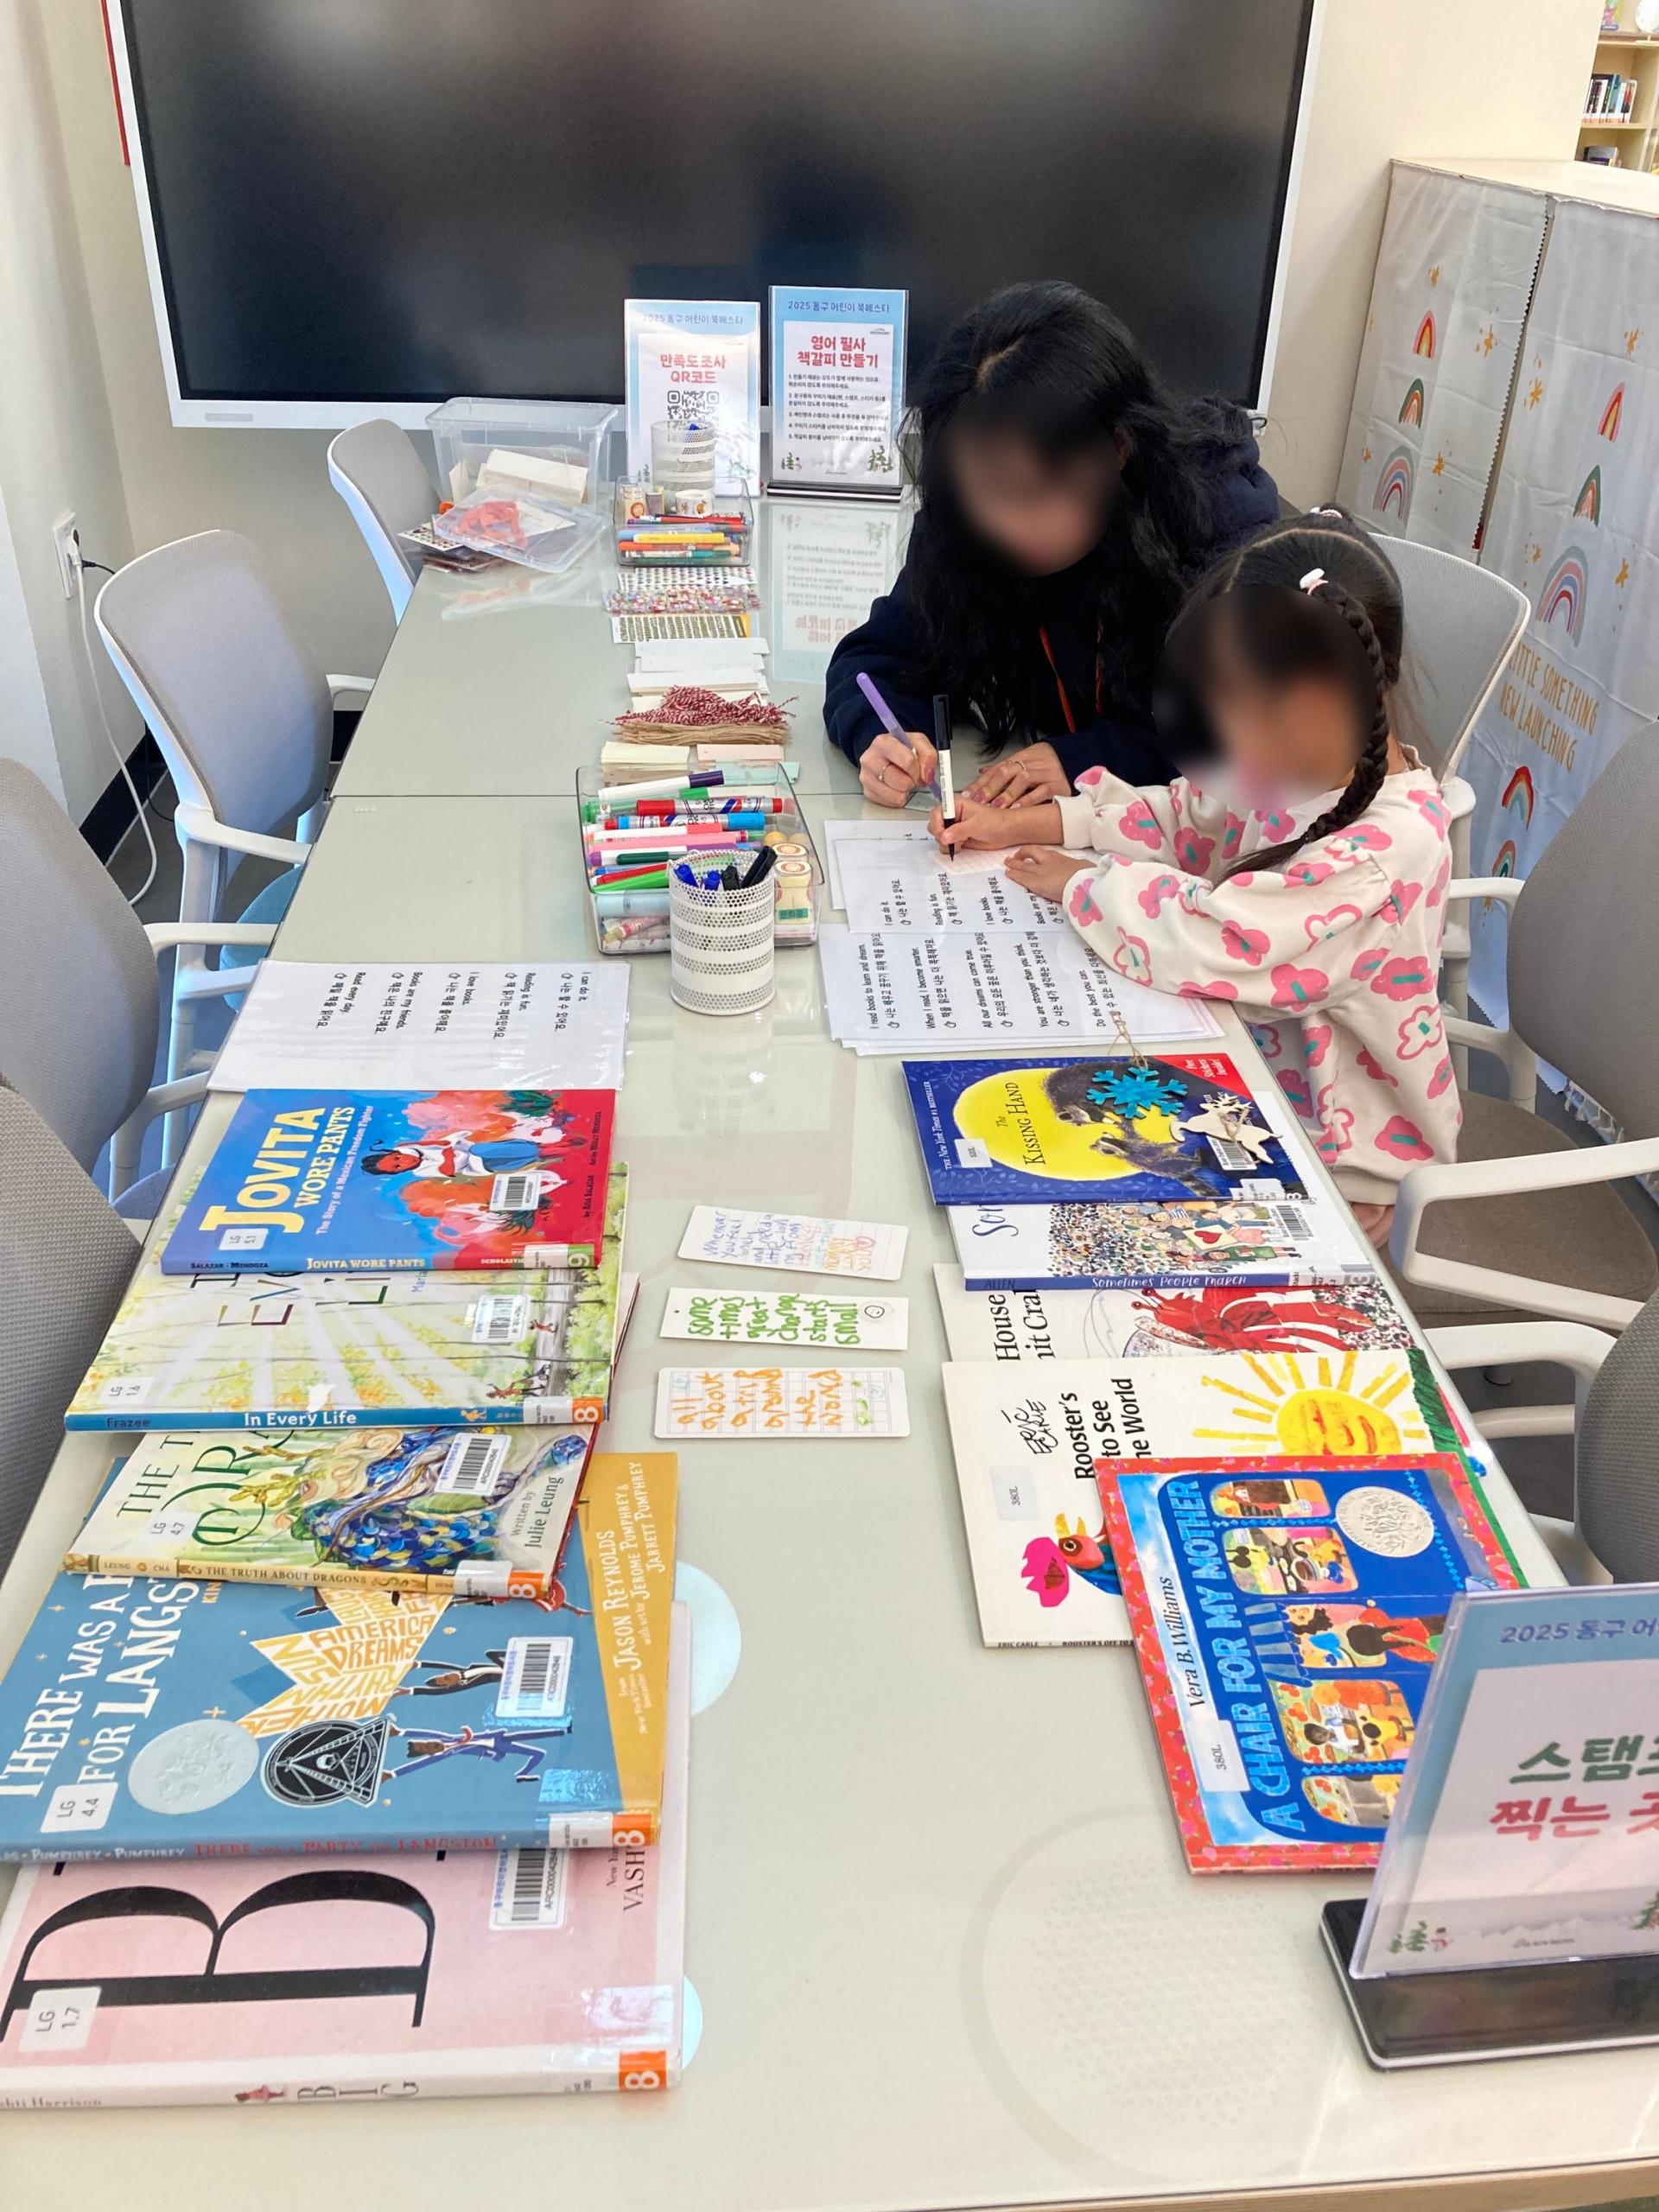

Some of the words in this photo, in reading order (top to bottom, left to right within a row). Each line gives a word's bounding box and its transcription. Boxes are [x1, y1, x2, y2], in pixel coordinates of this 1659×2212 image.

[812, 302, 830, 311] 동구
[830, 302, 855, 312] 어린이
[857, 303, 890, 313] 북페스타
[667, 315, 683, 324] 동구
[685, 315, 709, 324] 어린이
[712, 315, 743, 325] 북페스타
[811, 336, 836, 351] 영어
[840, 336, 866, 352] 필사
[798, 352, 836, 367] 책갈피
[840, 353, 878, 368] 만들기
[671, 371, 716, 384] QR코드
[1541, 664, 1599, 735] SOMETHING
[1498, 681, 1522, 721] NEW
[1517, 694, 1578, 772] LAUNCHING
[969, 963, 978, 976] come
[1020, 958, 1032, 967] you
[353, 972, 366, 985] Read
[410, 972, 423, 987] Books
[467, 976, 479, 987] love
[520, 973, 536, 992] Reading
[917, 969, 926, 988] become
[1024, 969, 1033, 980] than
[345, 987, 359, 1001] every
[388, 982, 402, 993] 책은
[406, 988, 415, 997] are
[446, 982, 459, 993] 나는
[561, 982, 573, 993] 나는
[1028, 982, 1042, 1003] stronger
[1083, 982, 1095, 992] you
[400, 999, 412, 1007] my
[865, 995, 876, 1010] books
[976, 988, 987, 1007] dreams
[1086, 994, 1097, 1006] best
[982, 1009, 990, 1019] our
[995, 1001, 1008, 1016] 우리의
[1036, 1006, 1046, 1014] are
[925, 1014, 936, 1028] When
[1039, 1017, 1049, 1027] You
[924, 1081, 937, 1108] BESTSELLER
[1005, 1082, 1028, 1115] HAND
[358, 1106, 373, 1127] Fighter
[929, 1116, 942, 1132] Times
[995, 1116, 1008, 1127] The
[346, 1128, 365, 1155] Freedom
[933, 1132, 946, 1144] York
[1017, 1118, 1046, 1165] KISSING
[294, 1156, 336, 1208] WORE
[316, 1107, 356, 1154] PANTS
[938, 1145, 950, 1158] New
[199, 1107, 326, 1233] JOVITA
[336, 1156, 356, 1185] Mexican
[943, 1159, 952, 1170] THE
[322, 1200, 340, 1219] Story
[315, 1221, 331, 1235] The
[307, 1258, 347, 1269] JOVITA
[350, 1258, 386, 1269] WORE
[389, 1258, 425, 1268] PANTS
[985, 1279, 1015, 1289] ALLEN
[688, 1296, 718, 1336] some
[718, 1297, 745, 1339] times
[745, 1296, 776, 1338] great
[988, 1294, 1020, 1361] House
[696, 1372, 726, 1430] about
[1111, 1378, 1142, 1434] World
[107, 1417, 151, 1428] Frazee
[245, 1413, 260, 1427] In
[266, 1412, 317, 1429] Every
[322, 1410, 357, 1426] Life
[1092, 1400, 1115, 1433] See
[1061, 1392, 1096, 1479] Rooster's
[1101, 1438, 1121, 1459] to
[118, 1464, 180, 1516] THE
[535, 1476, 563, 1514] Leung
[628, 1462, 653, 1521] PUMPHREY
[510, 1503, 530, 1536] Written
[522, 1491, 536, 1501] by
[615, 1492, 639, 1551] PUMPHREY
[524, 1519, 547, 1548] Julie
[1166, 1480, 1228, 1580] MOTHER
[645, 1518, 665, 1573] JARRETT
[104, 1561, 131, 1571] LEUNG
[207, 1566, 228, 1577] THE
[231, 1567, 270, 1579] TRUTH
[272, 1571, 309, 1582] ABOUT
[313, 1573, 366, 1586] DRAGONS
[596, 1529, 629, 1612] REYNOLDS
[627, 1554, 650, 1599] JEROME
[1160, 1576, 1185, 1644] Williams
[1196, 1582, 1242, 1629] MY
[308, 1613, 437, 1649] AMERICA
[1500, 1623, 1570, 1643] 2025
[1576, 1619, 1626, 1640] 동구
[92, 1576, 200, 1719] LANGS
[612, 1614, 642, 1670] JASON
[321, 1636, 425, 1670] DREAMS
[1178, 1649, 1192, 1664] B.
[1217, 1632, 1262, 1694] FOR
[0, 1688, 83, 1797] THERE
[59, 1622, 118, 1684] WAS
[90, 1592, 130, 1614] A
[1190, 1667, 1205, 1707] Vera
[77, 1724, 136, 1785] FOR
[1217, 1744, 1228, 1770] 380L
[1232, 1701, 1291, 1797] CHAIR
[57, 1799, 75, 1819] LG
[81, 1798, 100, 1817] 4.4
[1261, 1802, 1306, 1832] A
[1489, 1796, 1611, 1841] 찍는
[194, 1842, 251, 1856] THERE
[303, 1840, 362, 1853] PARTY
[398, 1837, 499, 1852] LANGSTON
[613, 1829, 646, 1847] 8
[31, 1848, 102, 1861] PUMPHREY
[115, 1847, 185, 1859] PUMPHREY
[607, 1867, 618, 1887] New
[35, 2010, 56, 2035] LG
[61, 2005, 80, 2030] 1.7
[624, 2069, 660, 2090] 8
[296, 2081, 420, 2101] BIG
[31, 2097, 102, 2108] Harrison
